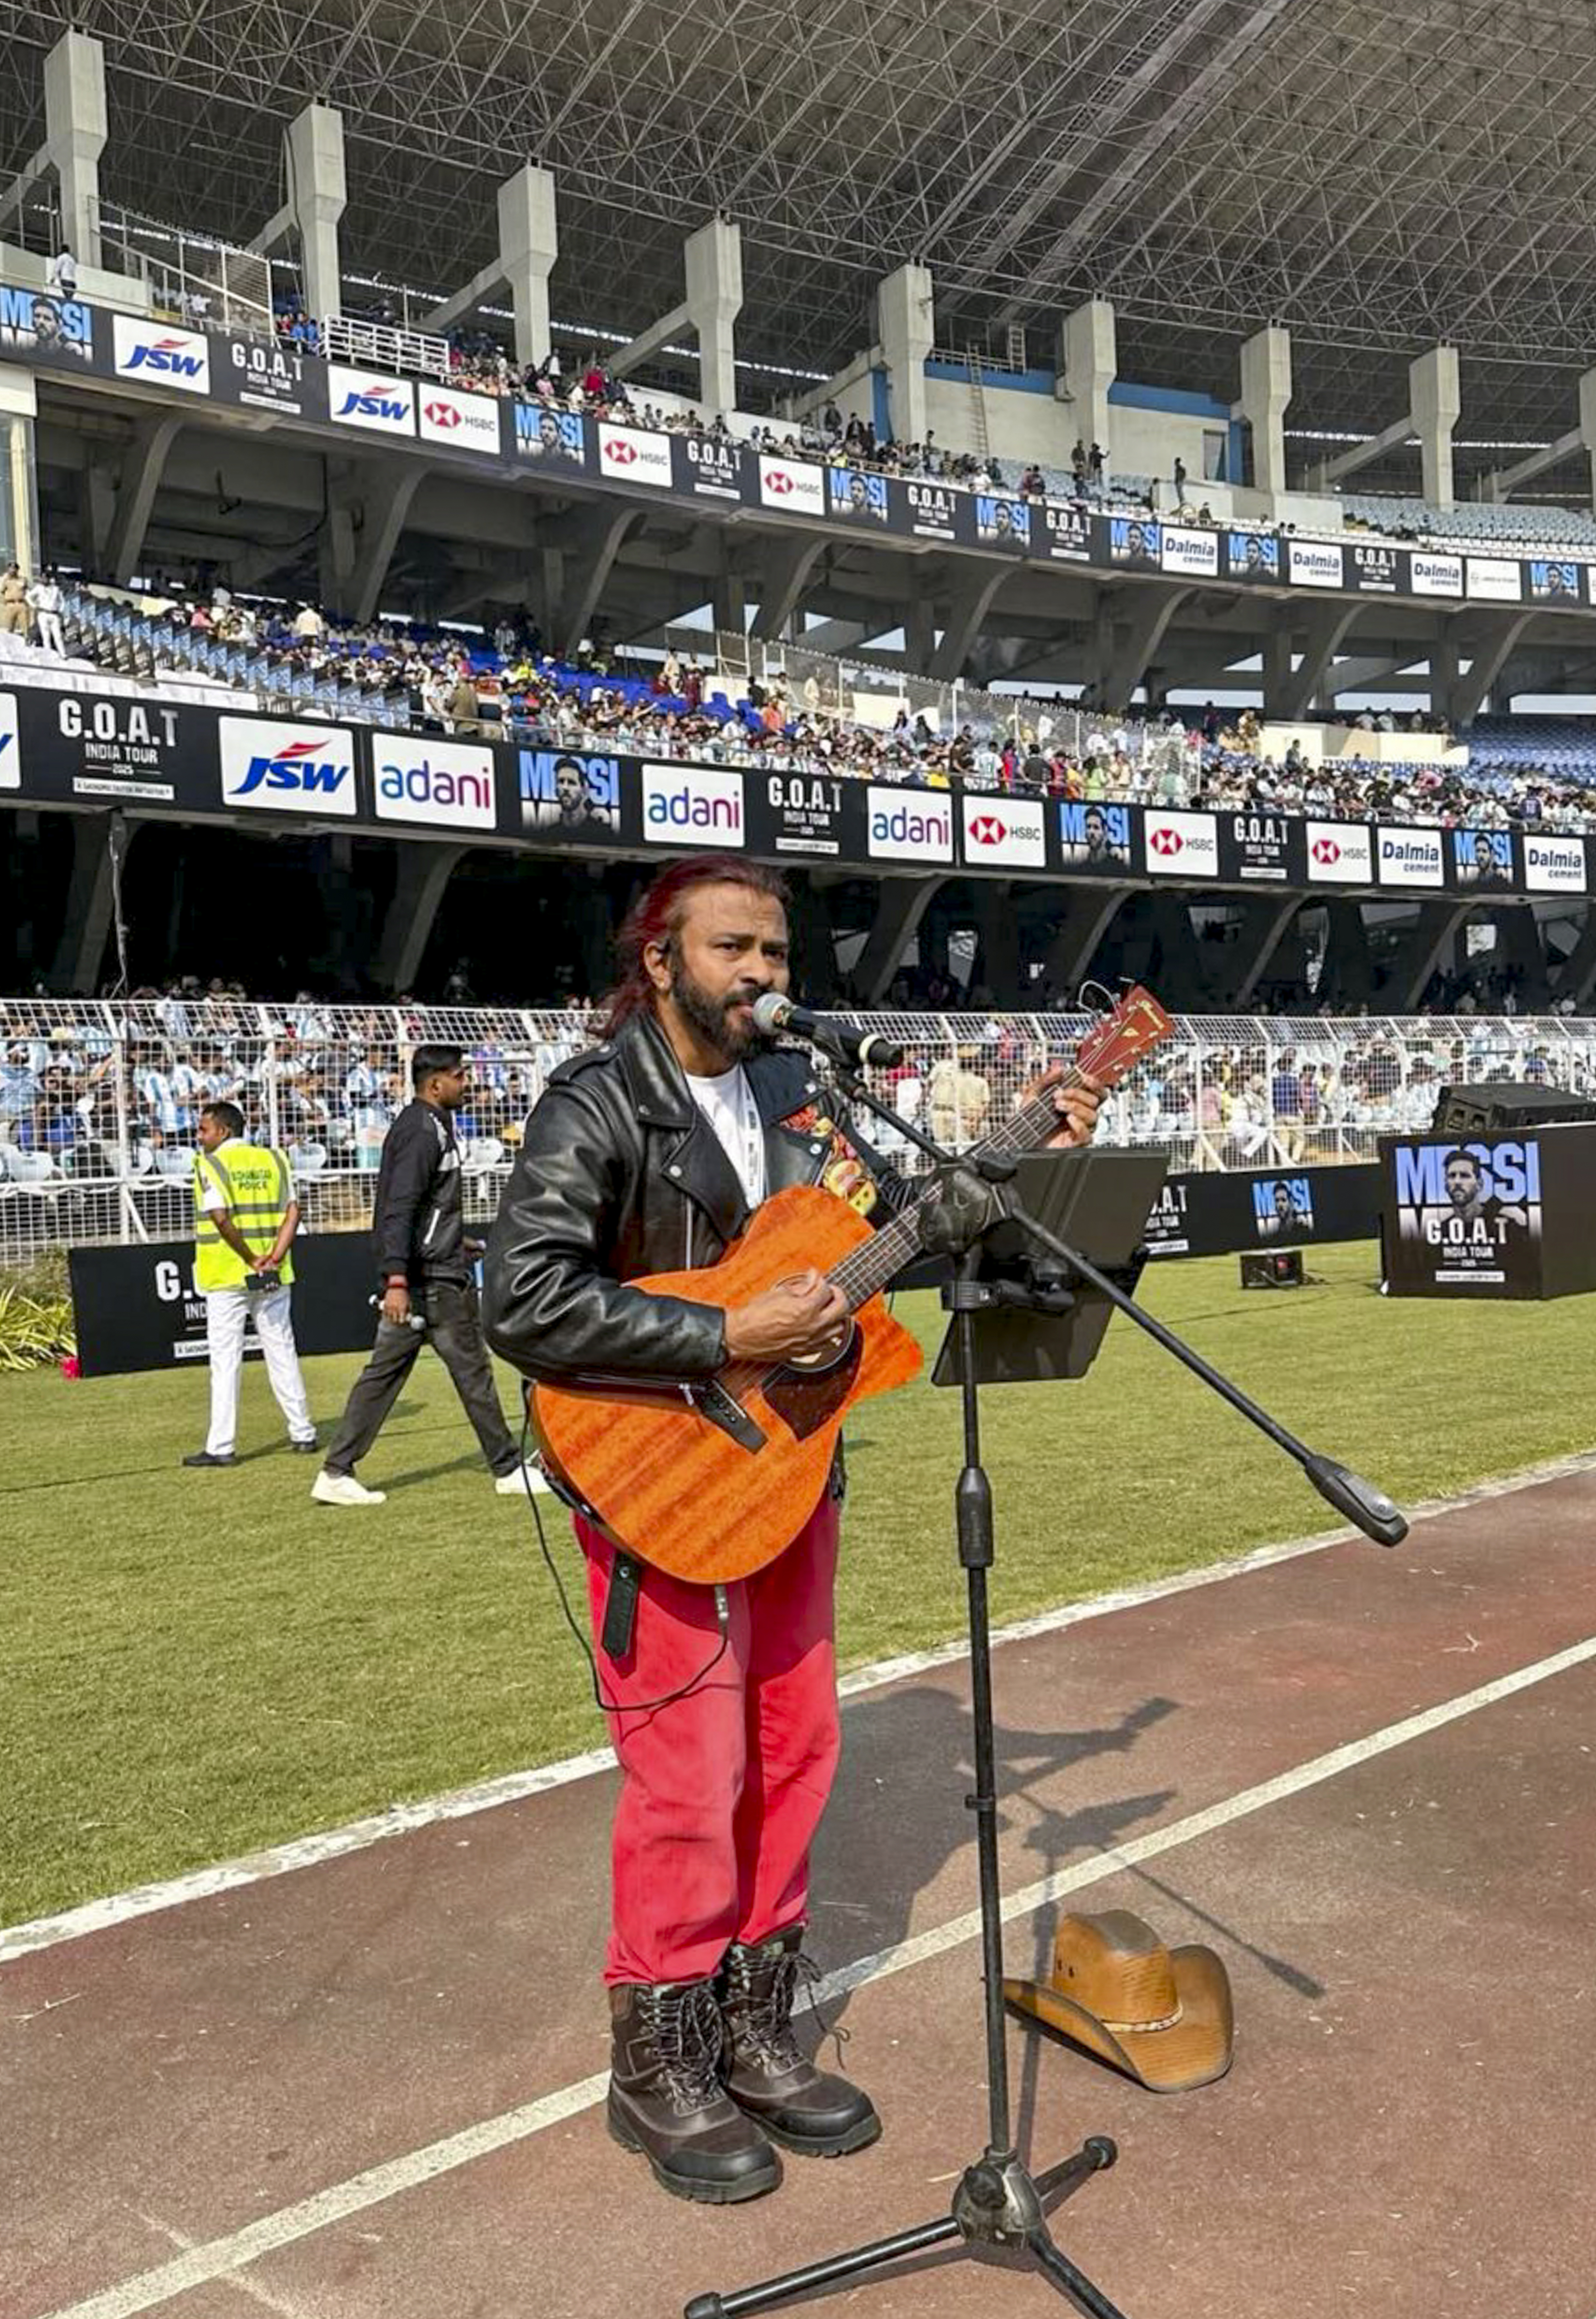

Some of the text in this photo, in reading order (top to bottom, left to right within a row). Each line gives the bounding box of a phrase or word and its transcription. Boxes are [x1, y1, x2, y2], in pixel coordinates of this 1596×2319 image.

[119, 345, 205, 376] JSW
[232, 343, 302, 381] G.O.A.T
[336, 392, 409, 419] JSW
[465, 416, 496, 432] HSBC
[640, 452, 668, 466] HSBC
[688, 440, 741, 470] G.O.A.T
[796, 483, 821, 495] HSBC
[908, 485, 956, 513] G.O.A.T
[1046, 510, 1091, 535] G.O.A.T
[1165, 537, 1215, 555] Dalmia
[1293, 551, 1340, 568] Dalmia
[1414, 562, 1460, 580] Dalmia
[59, 698, 179, 747] G.O.A.T
[85, 742, 158, 764] INDIA TOUR
[112, 763, 134, 775] 2025
[228, 757, 350, 794] JSW
[381, 759, 490, 809] adani
[768, 776, 842, 812] G.O.A.T
[648, 786, 740, 829] adani
[872, 807, 949, 845] adani
[1010, 827, 1040, 841] HSBC
[1234, 816, 1288, 844] G.O.A.T
[1186, 836, 1214, 851] HSBC
[1343, 845, 1368, 859] HSBC
[1382, 841, 1439, 861] Dalmia
[1403, 862, 1439, 873] cement
[1529, 848, 1582, 868] Dalmia
[1548, 868, 1582, 879] cement
[1426, 1217, 1509, 1245] G.O.A.T
